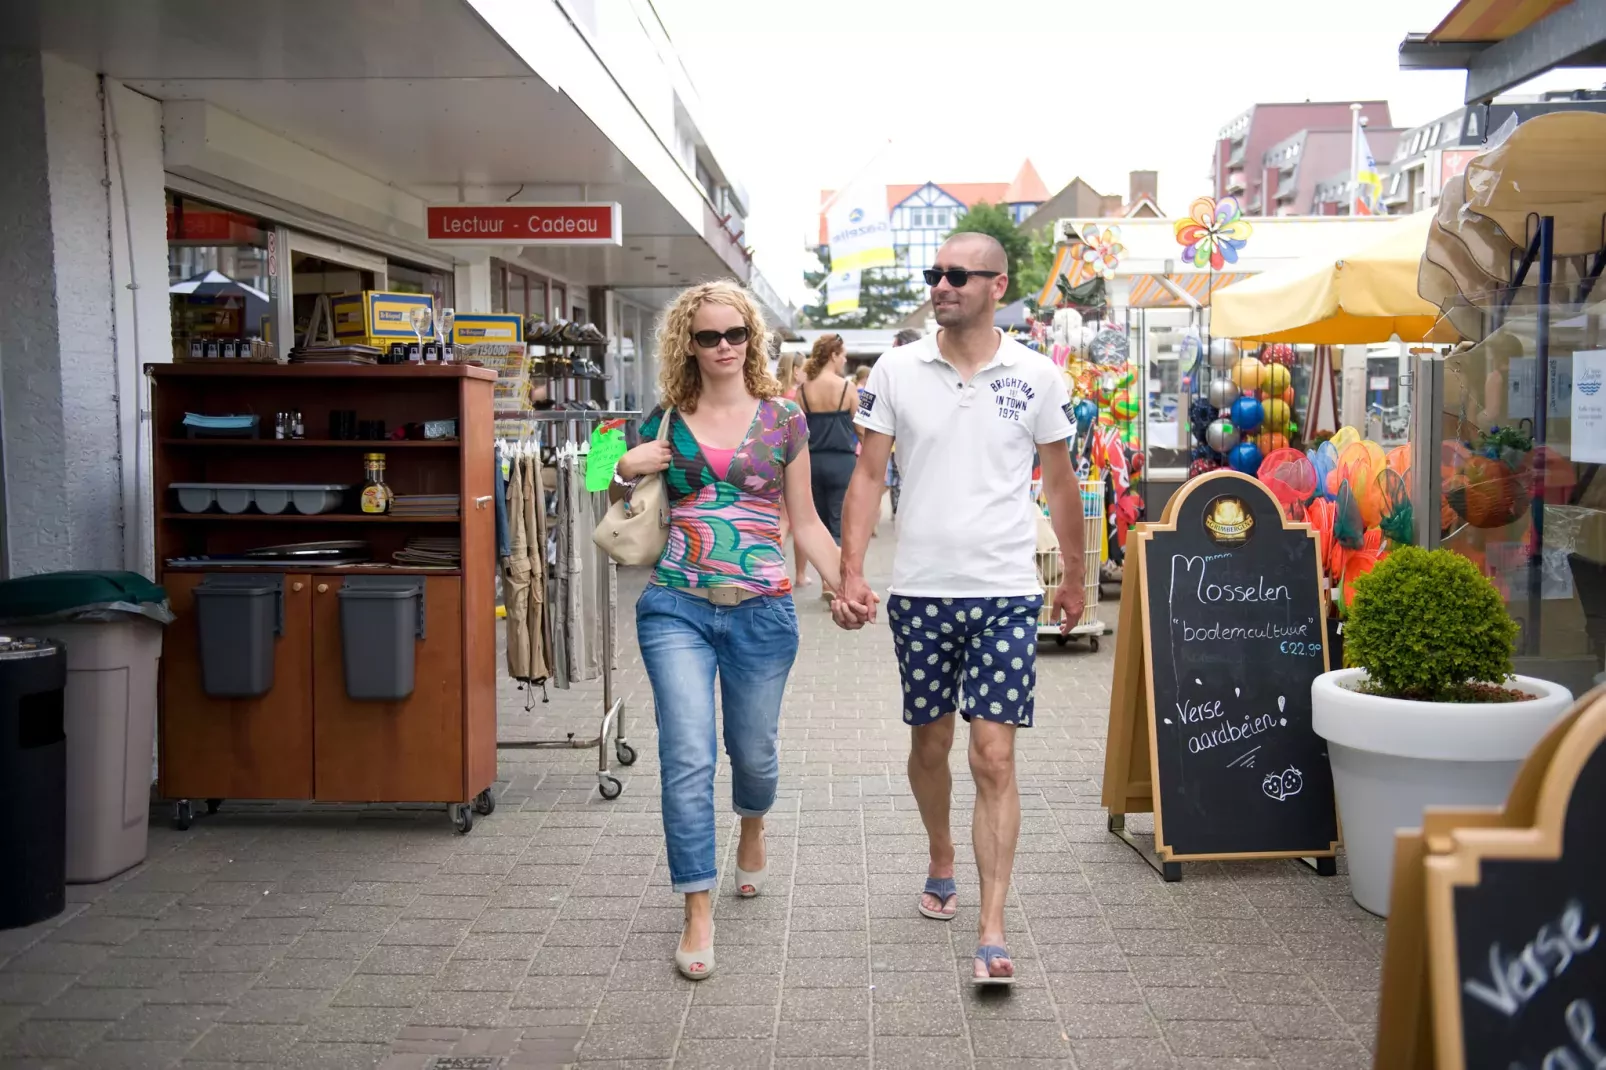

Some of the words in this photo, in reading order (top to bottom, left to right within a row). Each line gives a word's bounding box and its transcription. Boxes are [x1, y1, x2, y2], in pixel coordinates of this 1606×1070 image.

[443, 215, 504, 233] Lectuur
[527, 215, 598, 233] Cadeau
[996, 395, 1004, 406] IN
[1006, 397, 1027, 411] TOWN
[1168, 554, 1292, 604] Mosselen
[1176, 699, 1225, 725] Verse
[1463, 899, 1601, 1017] Verse
